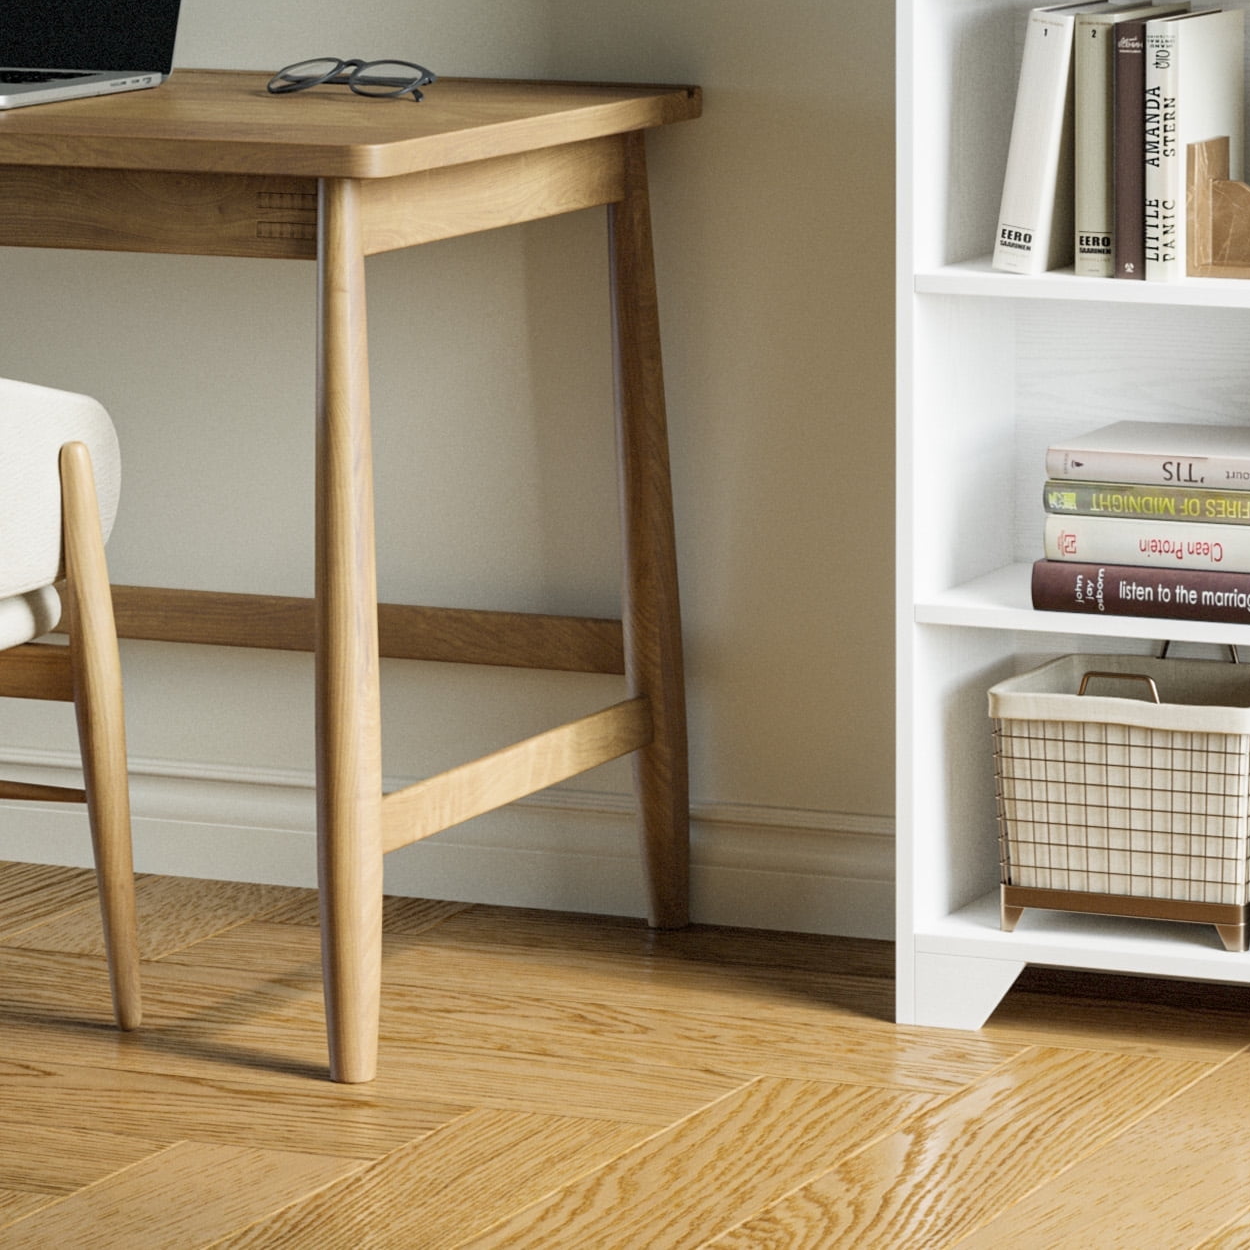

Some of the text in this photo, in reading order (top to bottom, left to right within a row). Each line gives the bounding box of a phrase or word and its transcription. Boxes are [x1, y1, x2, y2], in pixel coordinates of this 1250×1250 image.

[1092, 30, 1097, 38] 2
[1146, 86, 1160, 168] AMANDA
[1163, 97, 1176, 157] STERN
[1001, 228, 1032, 243] EERO
[1146, 198, 1160, 262] LITTLE
[1162, 199, 1176, 262] PANIC
[1080, 236, 1111, 246] EERO
[1091, 494, 1176, 514] MIDNIGHT
[1181, 498, 1200, 516] OF
[1206, 498, 1250, 519] FIRES
[1140, 539, 1223, 562] Clean Protein
[1074, 574, 1084, 603] john
[1085, 579, 1094, 600] jay
[1119, 582, 1154, 602] listen
[1158, 584, 1171, 602] to
[1176, 584, 1197, 604] the
